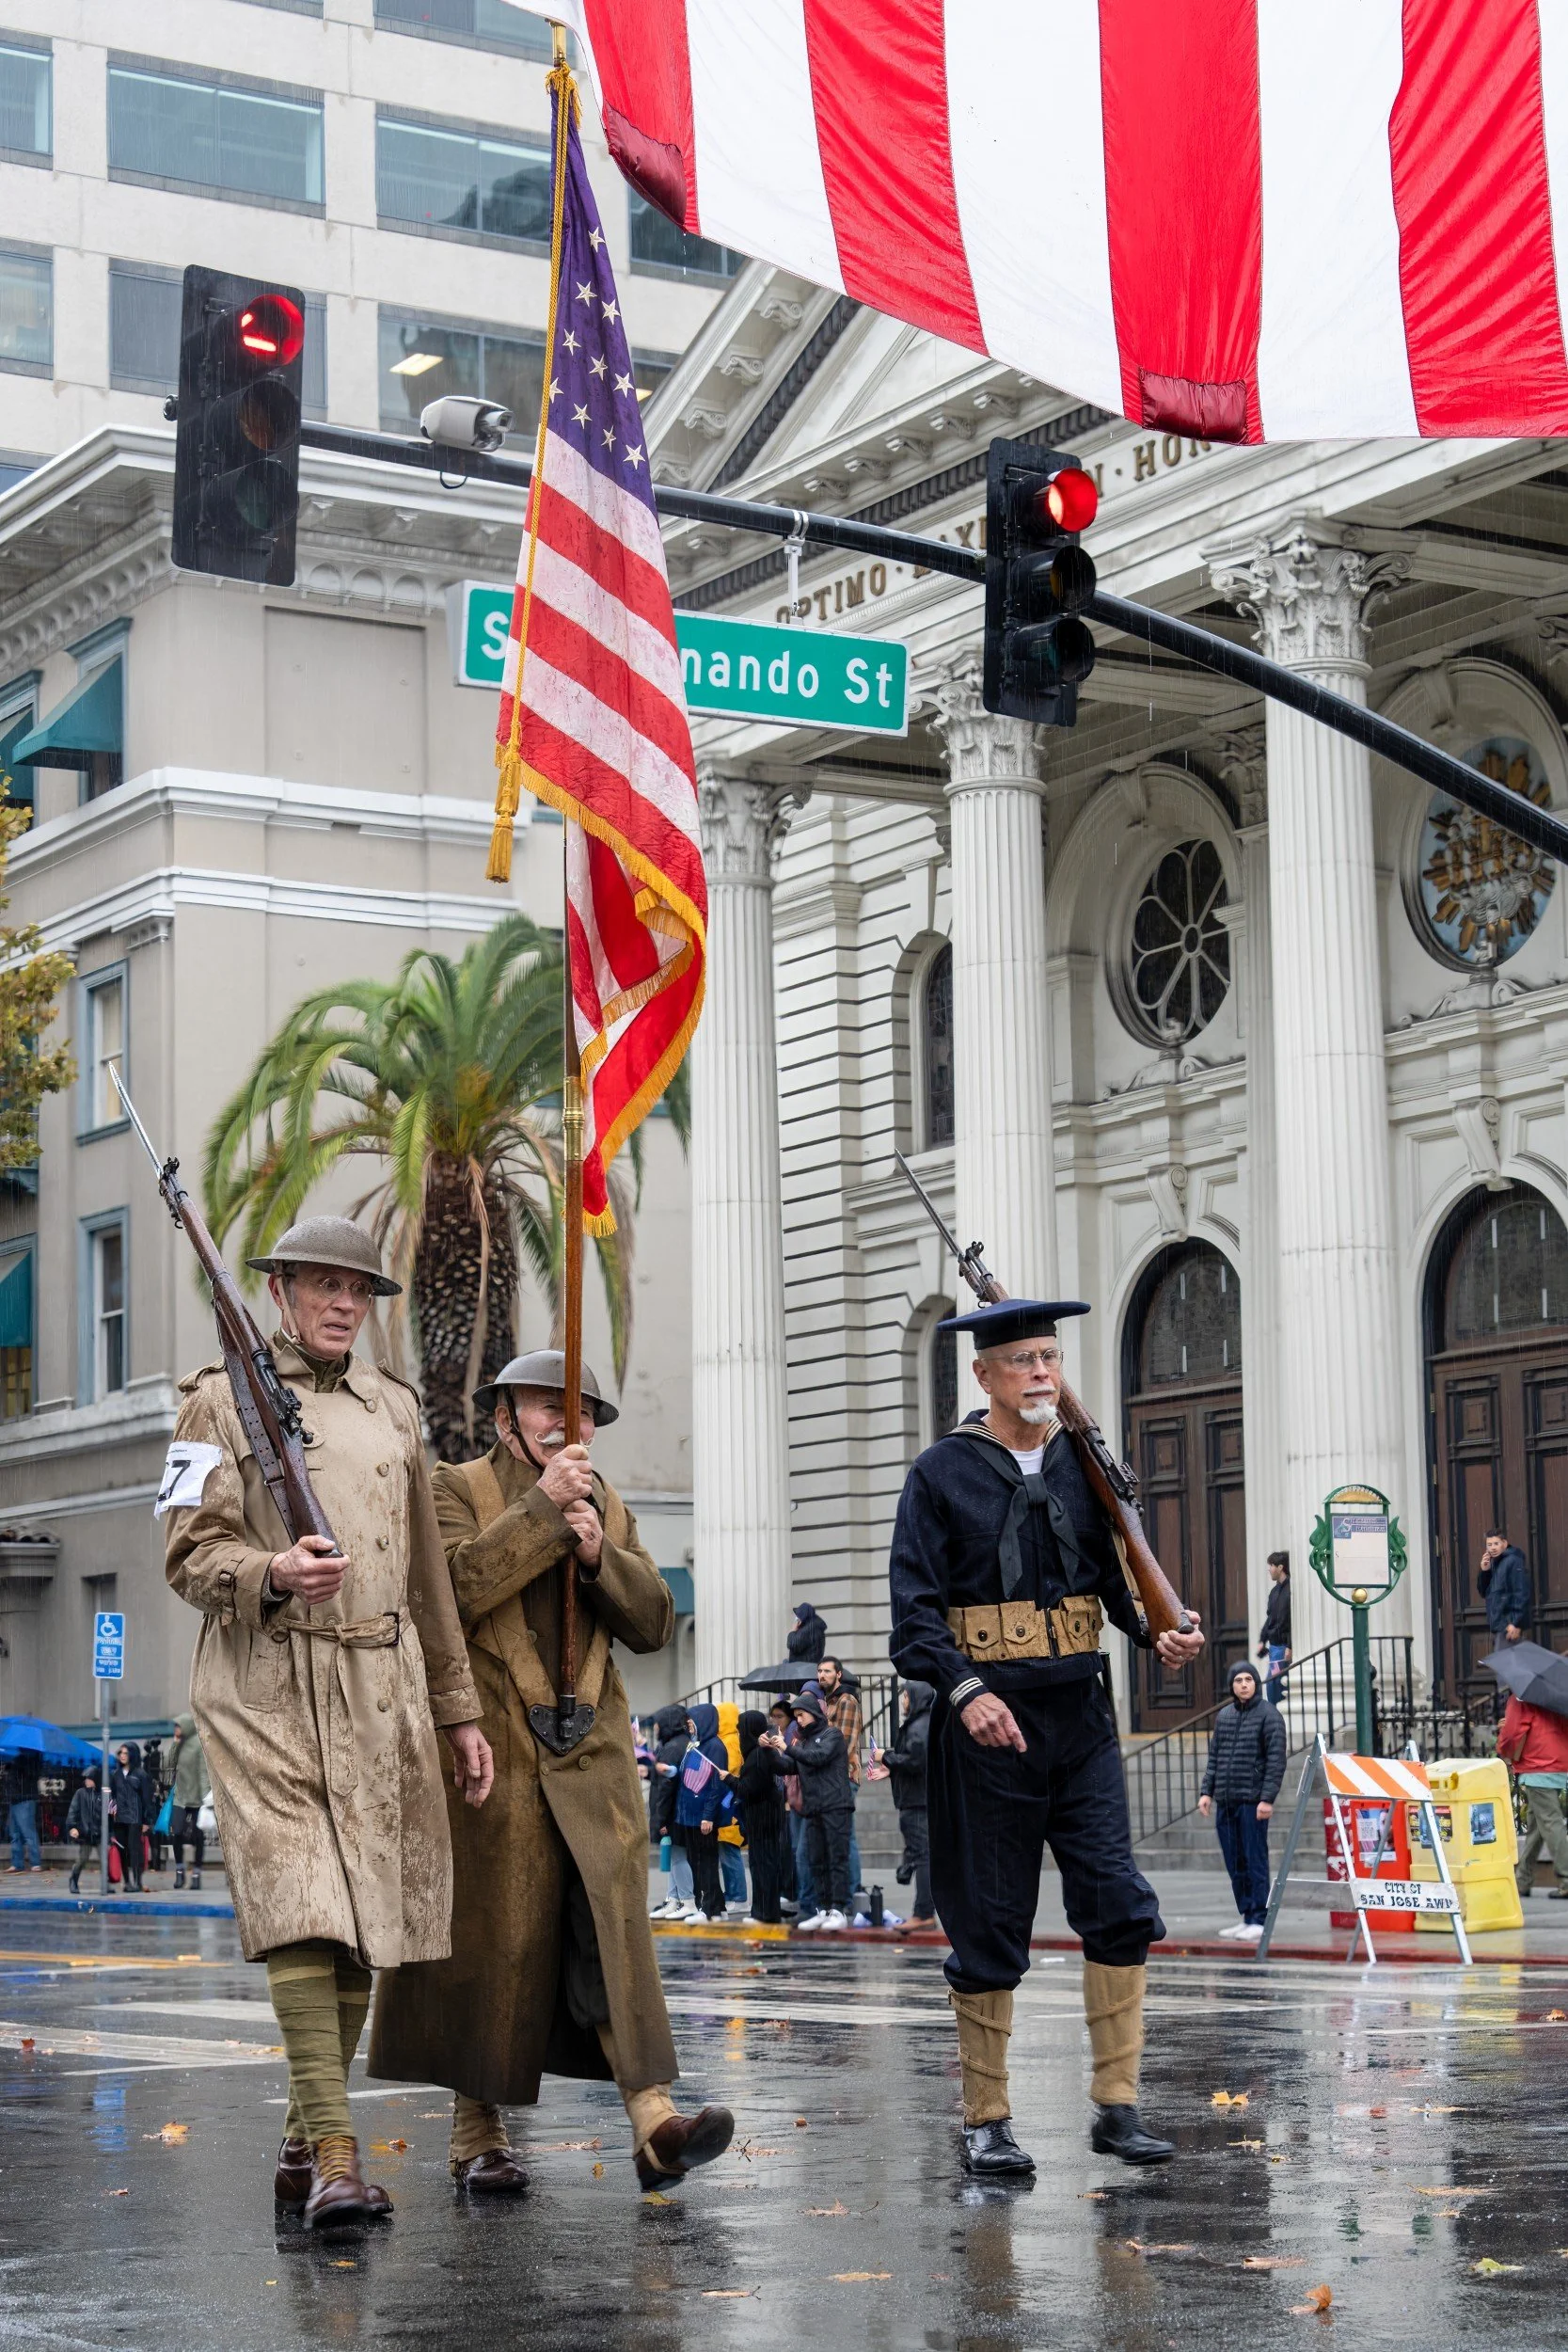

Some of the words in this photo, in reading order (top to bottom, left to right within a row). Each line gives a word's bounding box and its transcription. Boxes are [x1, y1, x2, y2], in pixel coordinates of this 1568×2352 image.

[844, 658, 893, 708] St
[1385, 1882, 1406, 1894] CITY
[1360, 1894, 1385, 1906] SAN
[1390, 1896, 1420, 1908] JOSE
